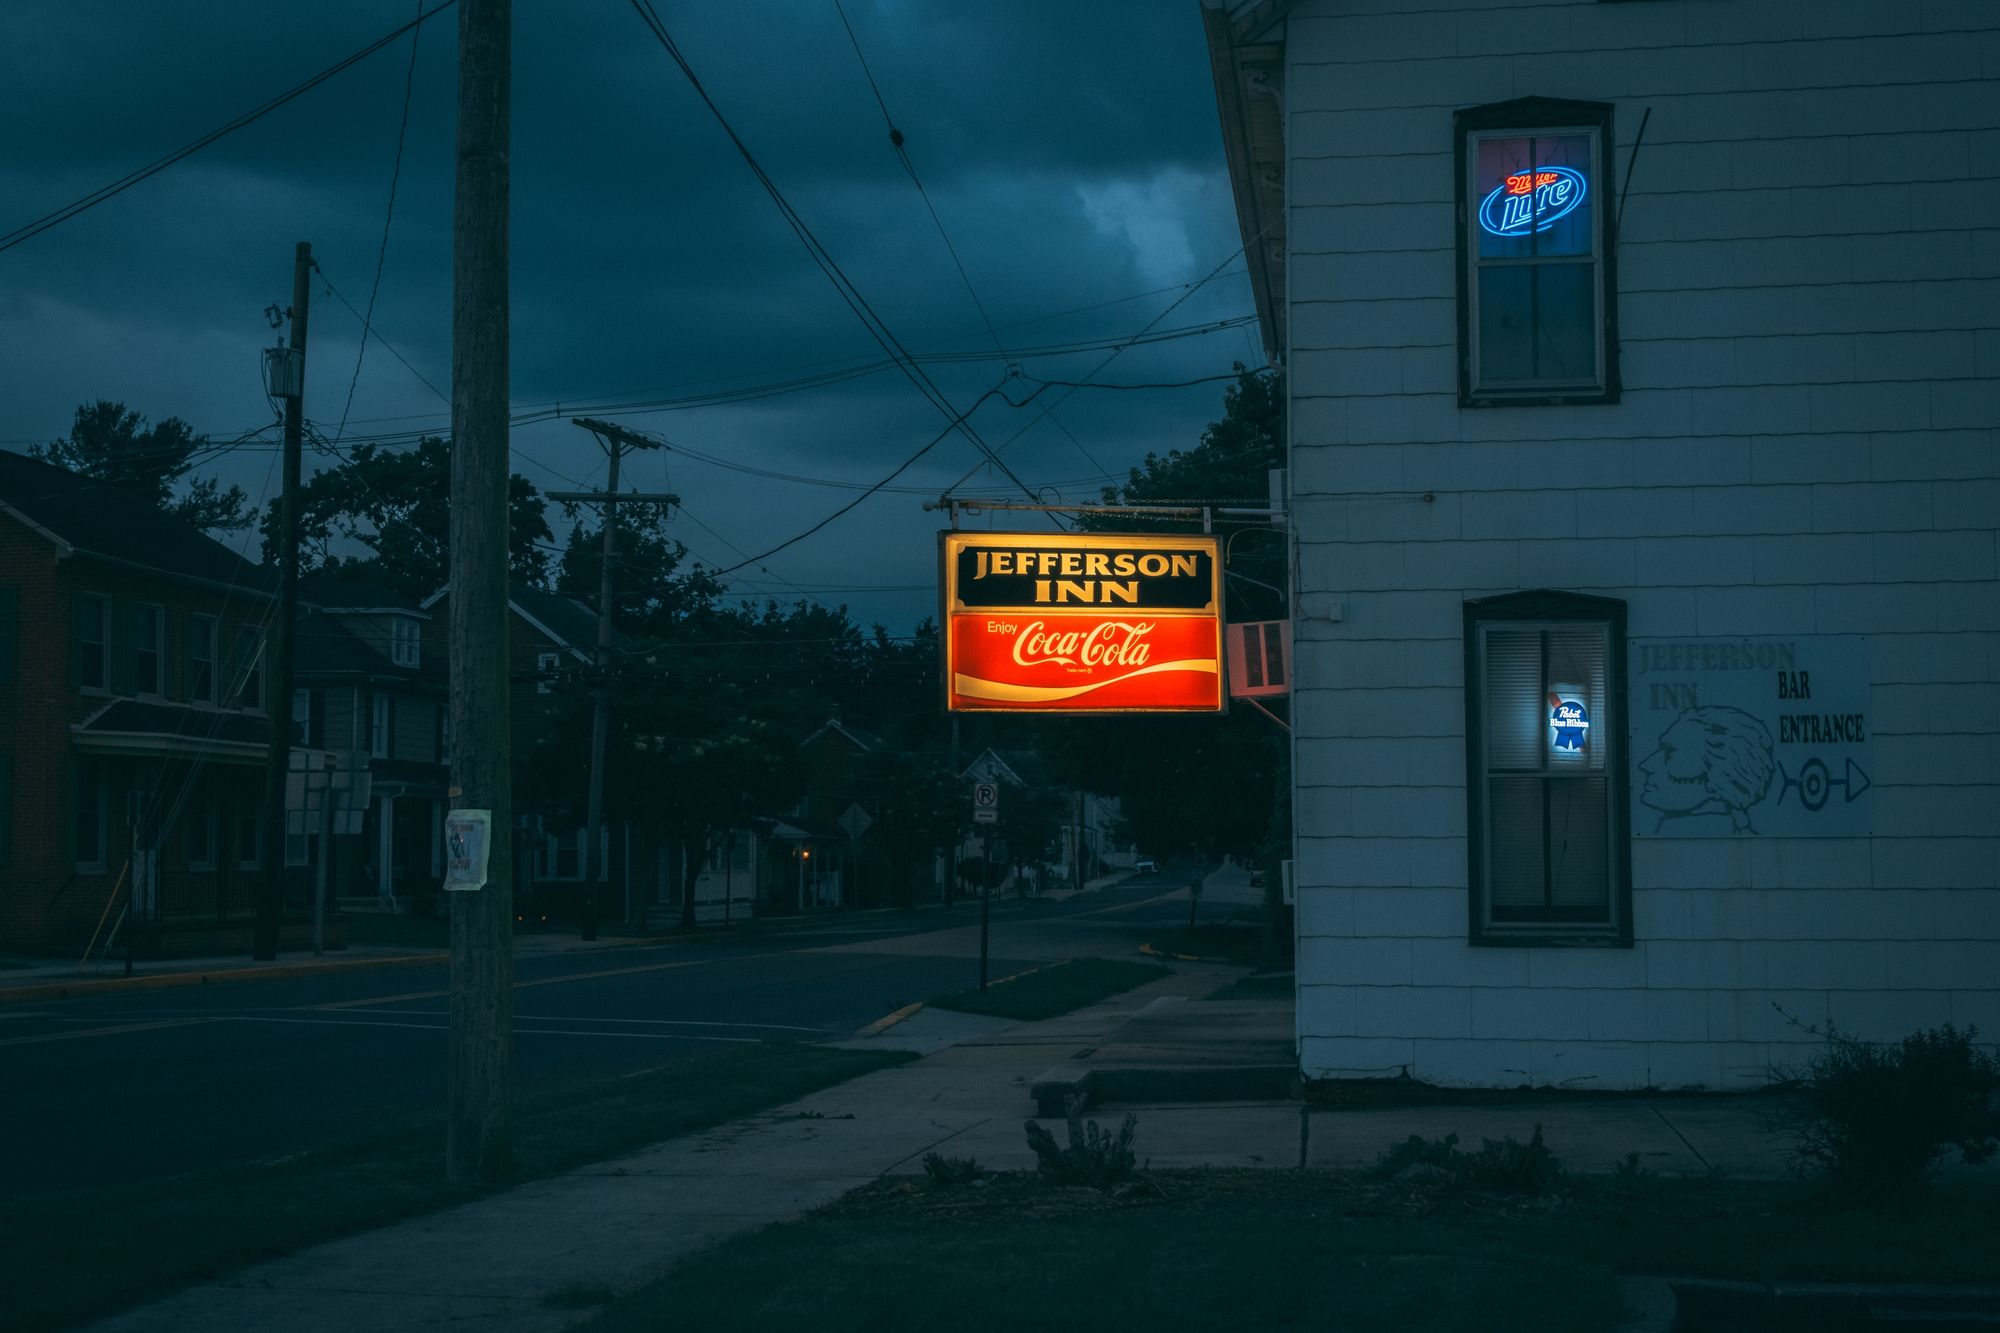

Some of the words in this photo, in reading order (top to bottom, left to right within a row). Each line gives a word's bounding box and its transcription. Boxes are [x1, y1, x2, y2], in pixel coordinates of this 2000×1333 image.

[1506, 173, 1558, 194] Mller
[973, 552, 1197, 580] JEFFERSON
[1035, 579, 1140, 604] INN
[987, 621, 1018, 636] Enjoy
[1012, 620, 1156, 667] Coca-Cola
[1637, 642, 1796, 676] JEFFERSON
[1649, 683, 1698, 710] INN
[1778, 670, 1811, 699] BAR
[1549, 718, 1566, 727] Blue
[1566, 718, 1590, 728] Ribbon
[1559, 706, 1582, 719] Pabst
[1779, 714, 1865, 743] ENTRANCE
